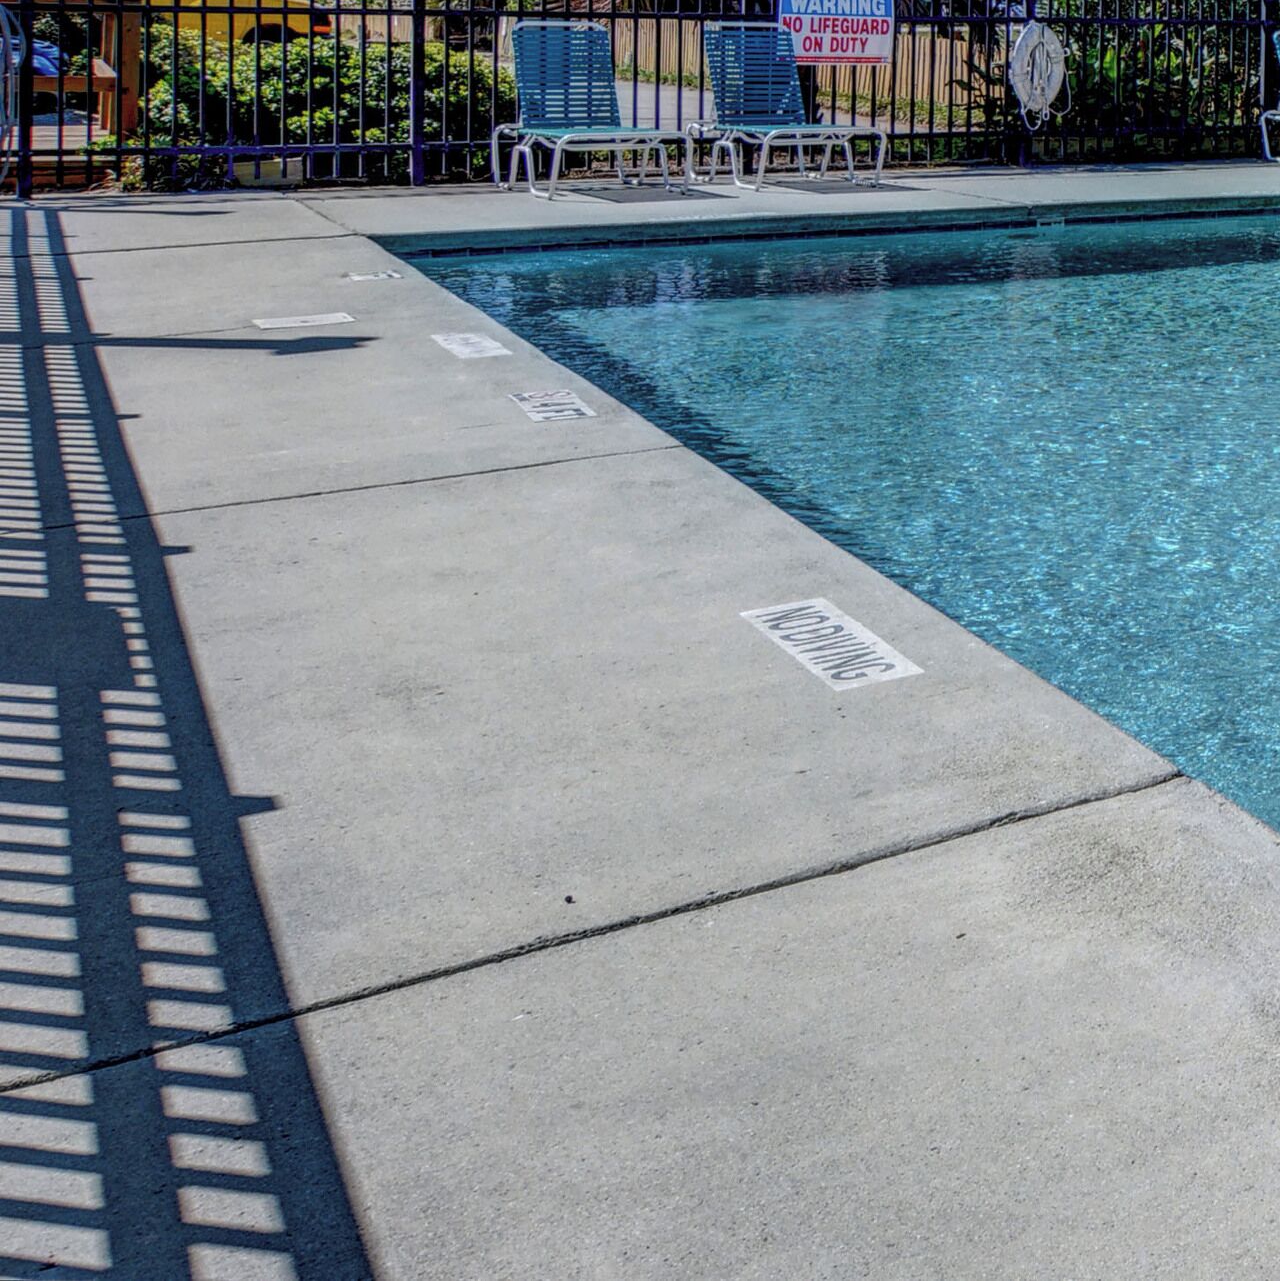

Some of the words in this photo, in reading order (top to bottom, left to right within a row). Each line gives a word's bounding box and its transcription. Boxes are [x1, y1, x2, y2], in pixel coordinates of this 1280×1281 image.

[782, 16, 803, 33] NO
[810, 17, 890, 35] LIFEGUARD
[802, 36, 823, 53] ON
[829, 37, 869, 53] DUTY
[755, 605, 831, 631] NO
[778, 623, 897, 681] DIVING
